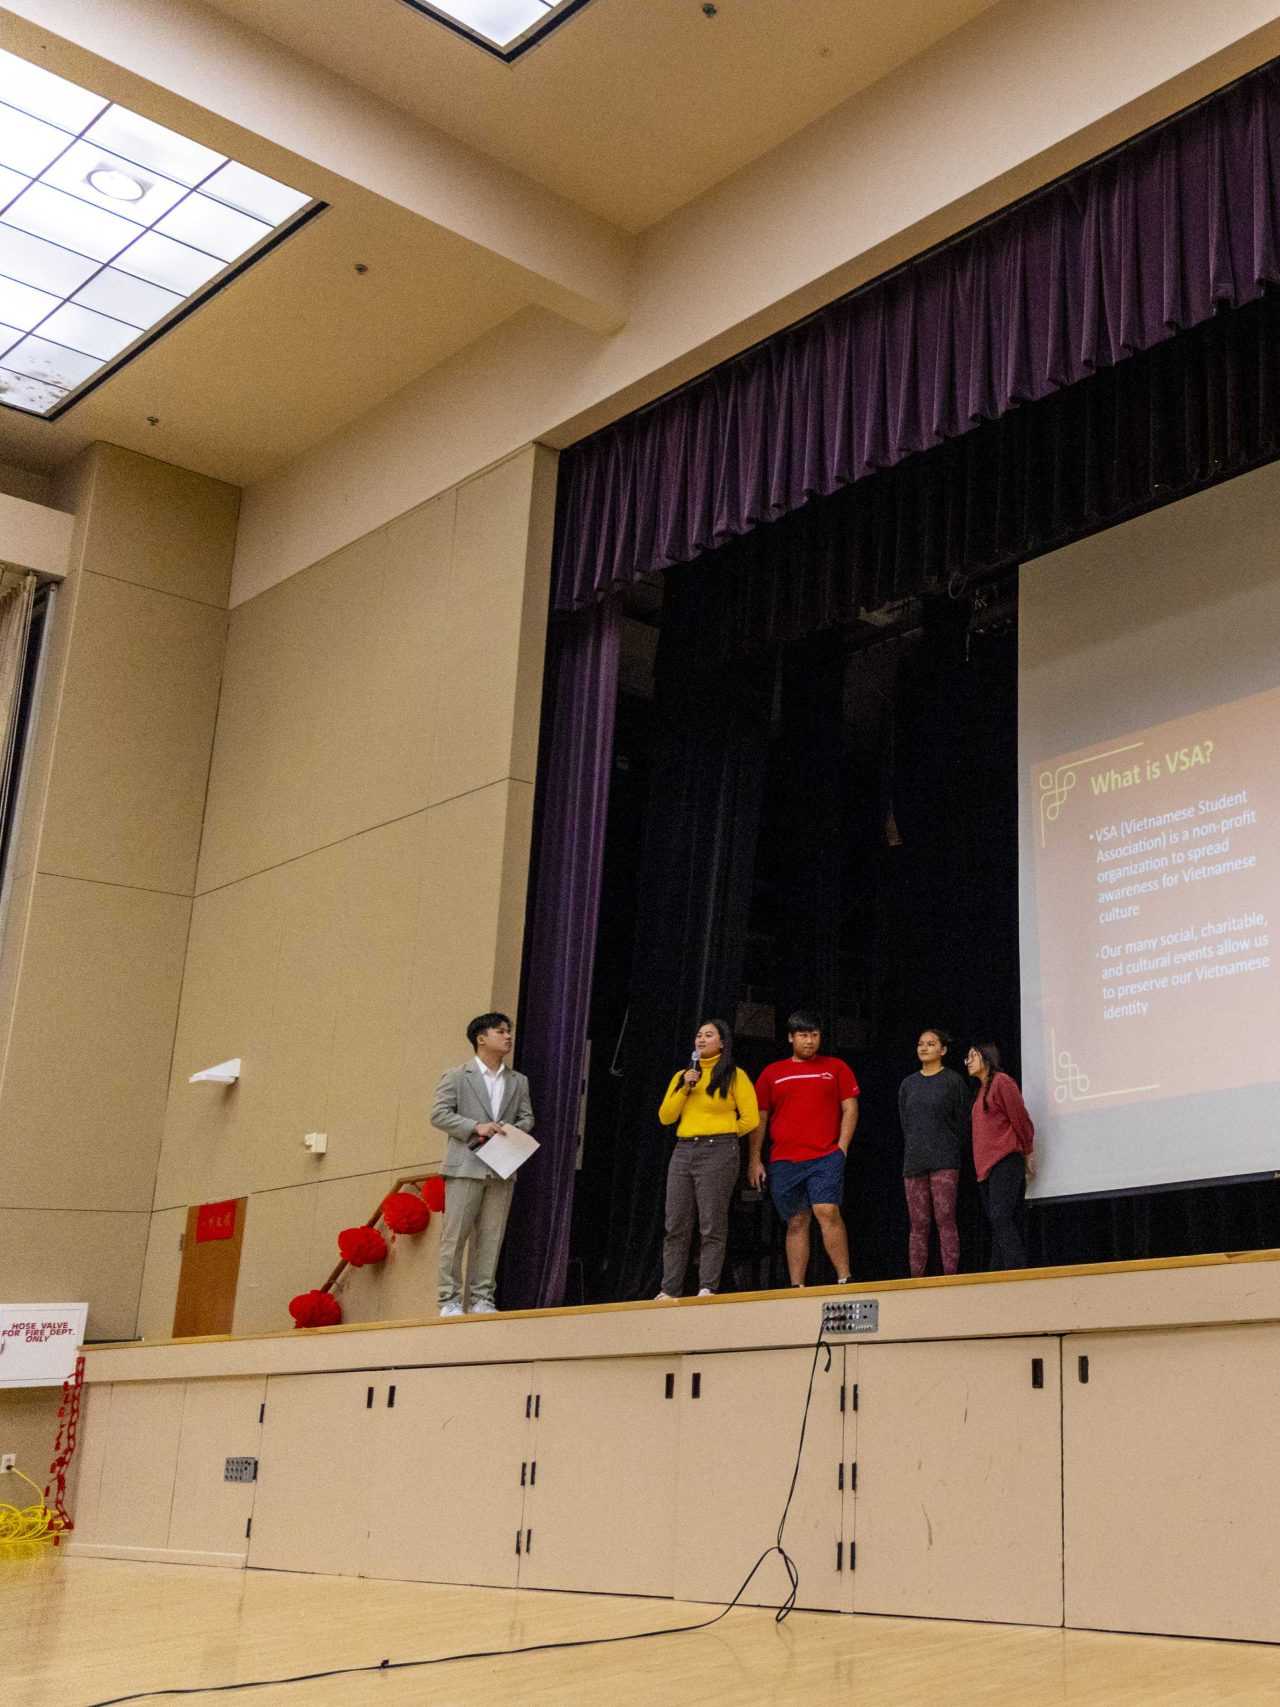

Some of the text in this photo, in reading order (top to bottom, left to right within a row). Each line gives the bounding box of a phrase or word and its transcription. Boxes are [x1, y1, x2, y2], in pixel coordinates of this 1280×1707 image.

[1090, 741, 1214, 795] What is VSA?
[1095, 790, 1247, 842] VSA (Vietnamese Student
[1096, 810, 1257, 864] Association) is a non-profit
[1097, 838, 1230, 884] organization to spread
[1097, 854, 1257, 904] awareness for Vietnamese
[1099, 903, 1140, 924] culture
[1101, 912, 1268, 959] Our many social, charitable,
[1102, 935, 1269, 980] and cultural events allow us
[1103, 956, 1270, 1000] to preserve our Vietnamese
[1104, 1000, 1149, 1020] identity
[11, 1322, 37, 1330] HOSE
[49, 1328, 75, 1336] DEPT.
